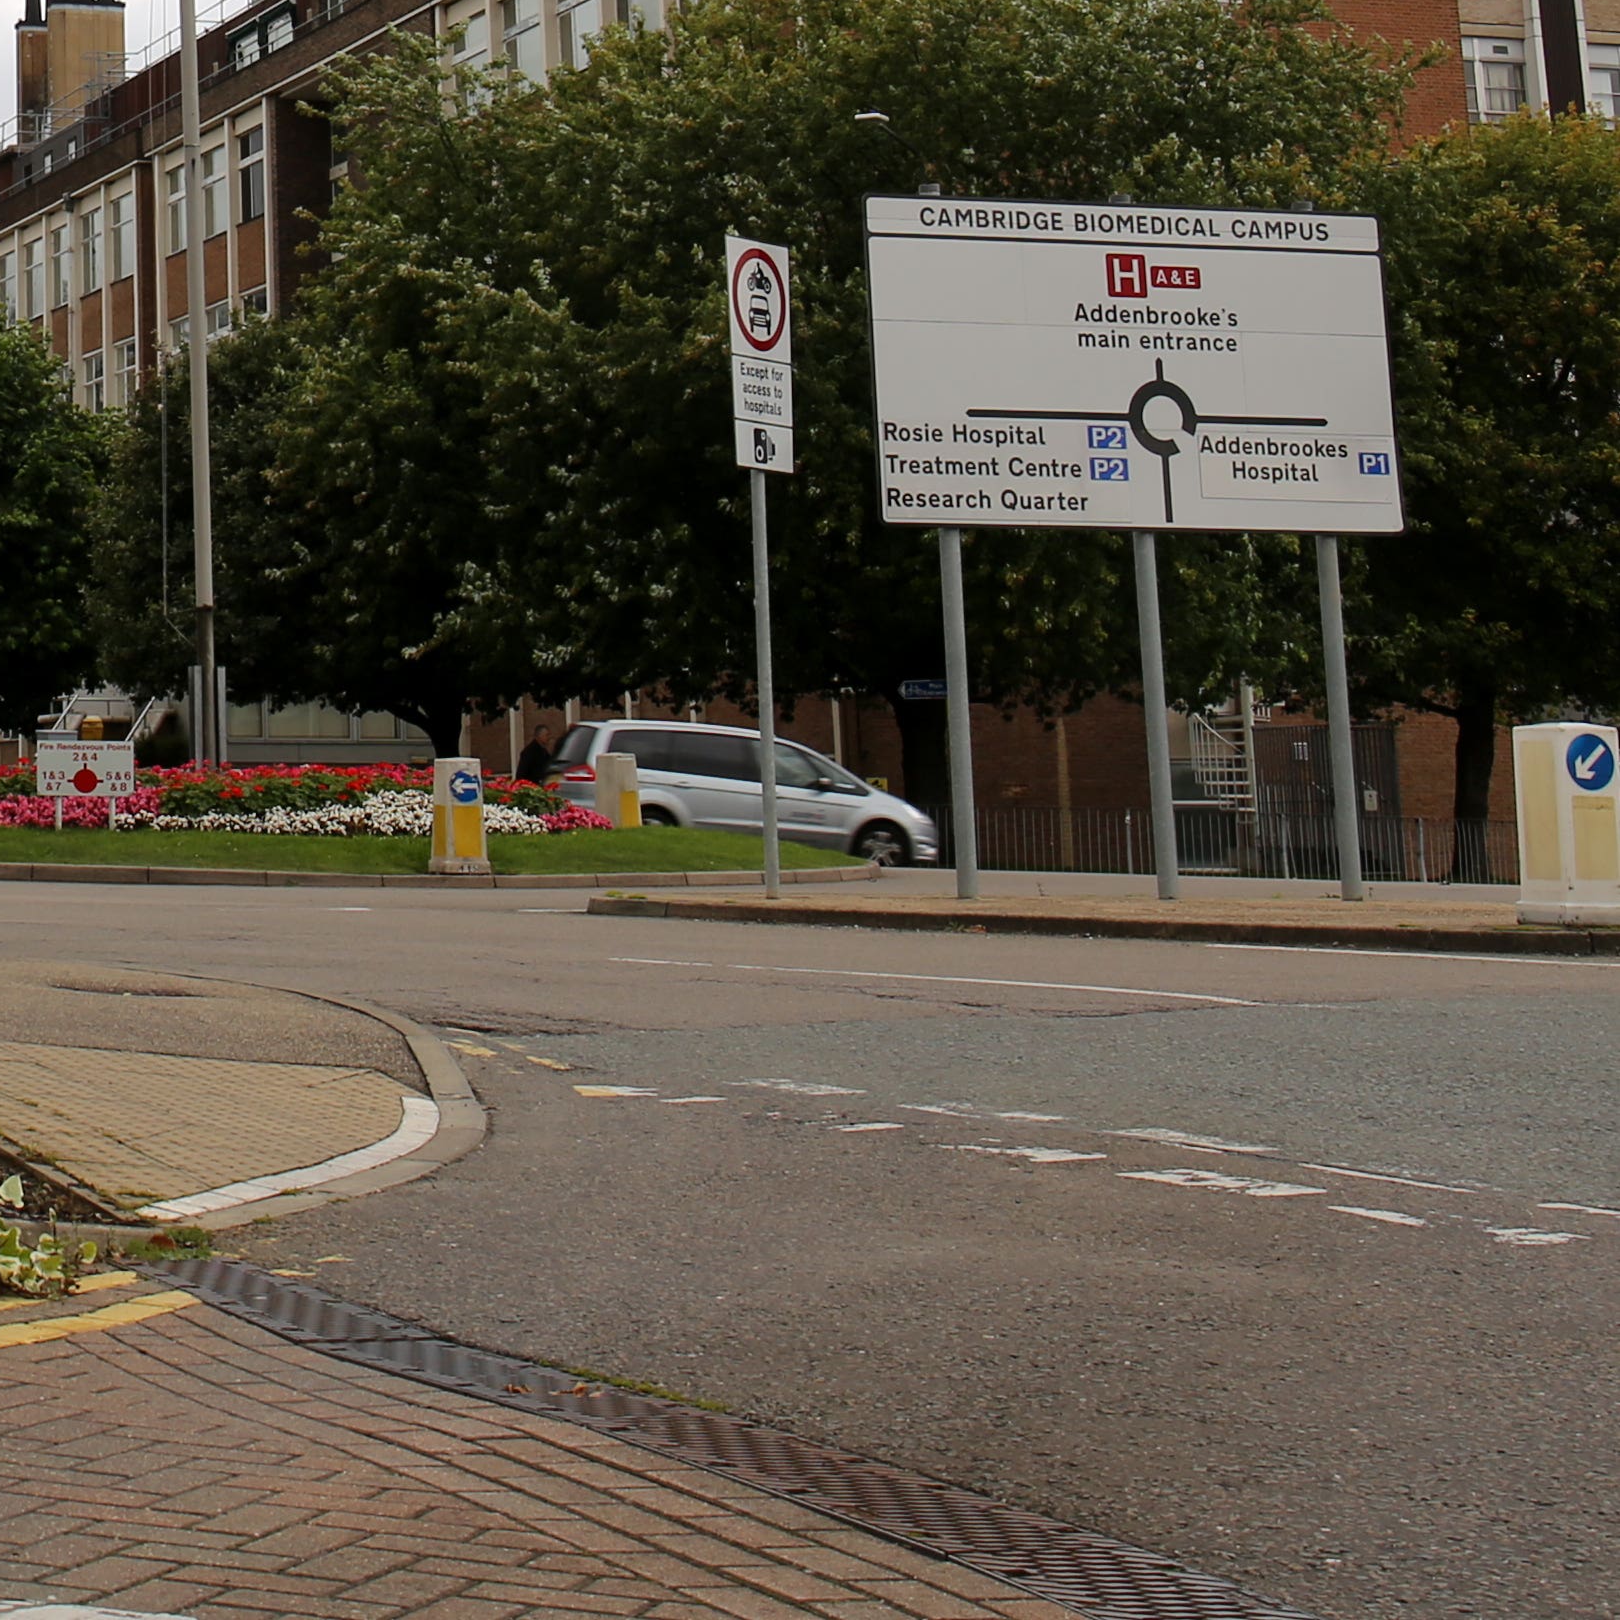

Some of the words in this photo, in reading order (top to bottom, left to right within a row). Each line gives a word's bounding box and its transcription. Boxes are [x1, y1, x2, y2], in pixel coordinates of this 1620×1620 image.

[919, 206, 1064, 232] CAMBRIDGE
[1073, 212, 1221, 238] BIOMEDICAL
[1231, 219, 1330, 242] CAMPUS
[1113, 258, 1141, 294] H
[1074, 303, 1239, 327] Addenbrooke's
[1077, 329, 1130, 348] main
[1139, 332, 1238, 352] entrance
[741, 362, 769, 381] Except
[771, 367, 783, 381] for
[743, 383, 771, 397] access
[774, 386, 782, 399] to
[744, 398, 782, 416] hospitals
[883, 422, 944, 442] Rosie
[952, 423, 1046, 447] Hospital
[1092, 427, 1124, 448] P2
[1200, 435, 1348, 458] Addenbrookes
[885, 454, 999, 476] Treatment
[1008, 456, 1082, 478] Centre
[1093, 458, 1125, 480] P2
[1232, 461, 1319, 484] Hospital
[1362, 453, 1387, 474] P1
[887, 488, 992, 509] Research
[1001, 489, 1089, 511] Quarter
[57, 743, 104, 751] Rendezvous
